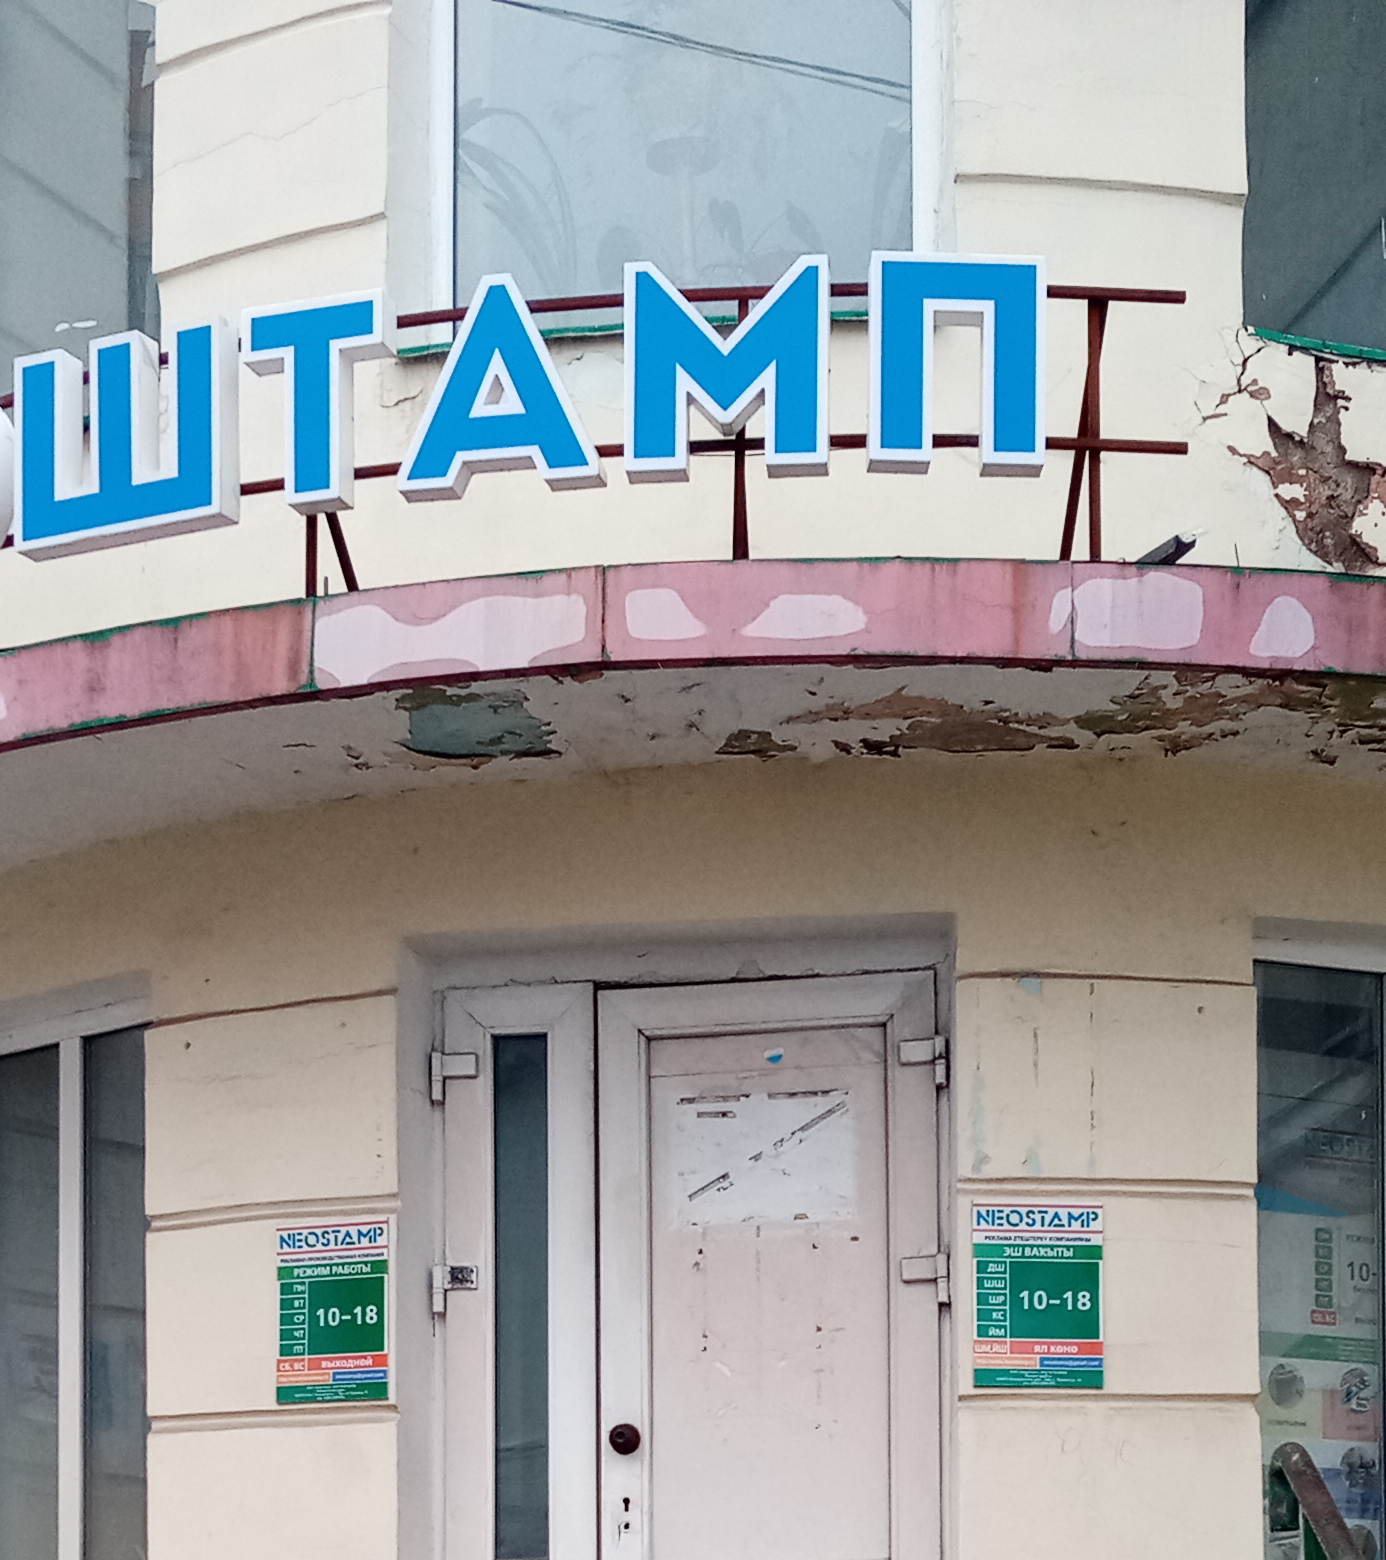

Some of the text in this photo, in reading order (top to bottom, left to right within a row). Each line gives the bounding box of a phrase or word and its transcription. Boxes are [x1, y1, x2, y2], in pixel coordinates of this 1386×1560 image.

[976, 1209, 1099, 1228] NEOSTAMP
[279, 1226, 385, 1250] NEOSTAMP
[1002, 1246, 1022, 1257] ЭШ
[293, 1263, 372, 1278] РЕЖИМ РАБОТЫ
